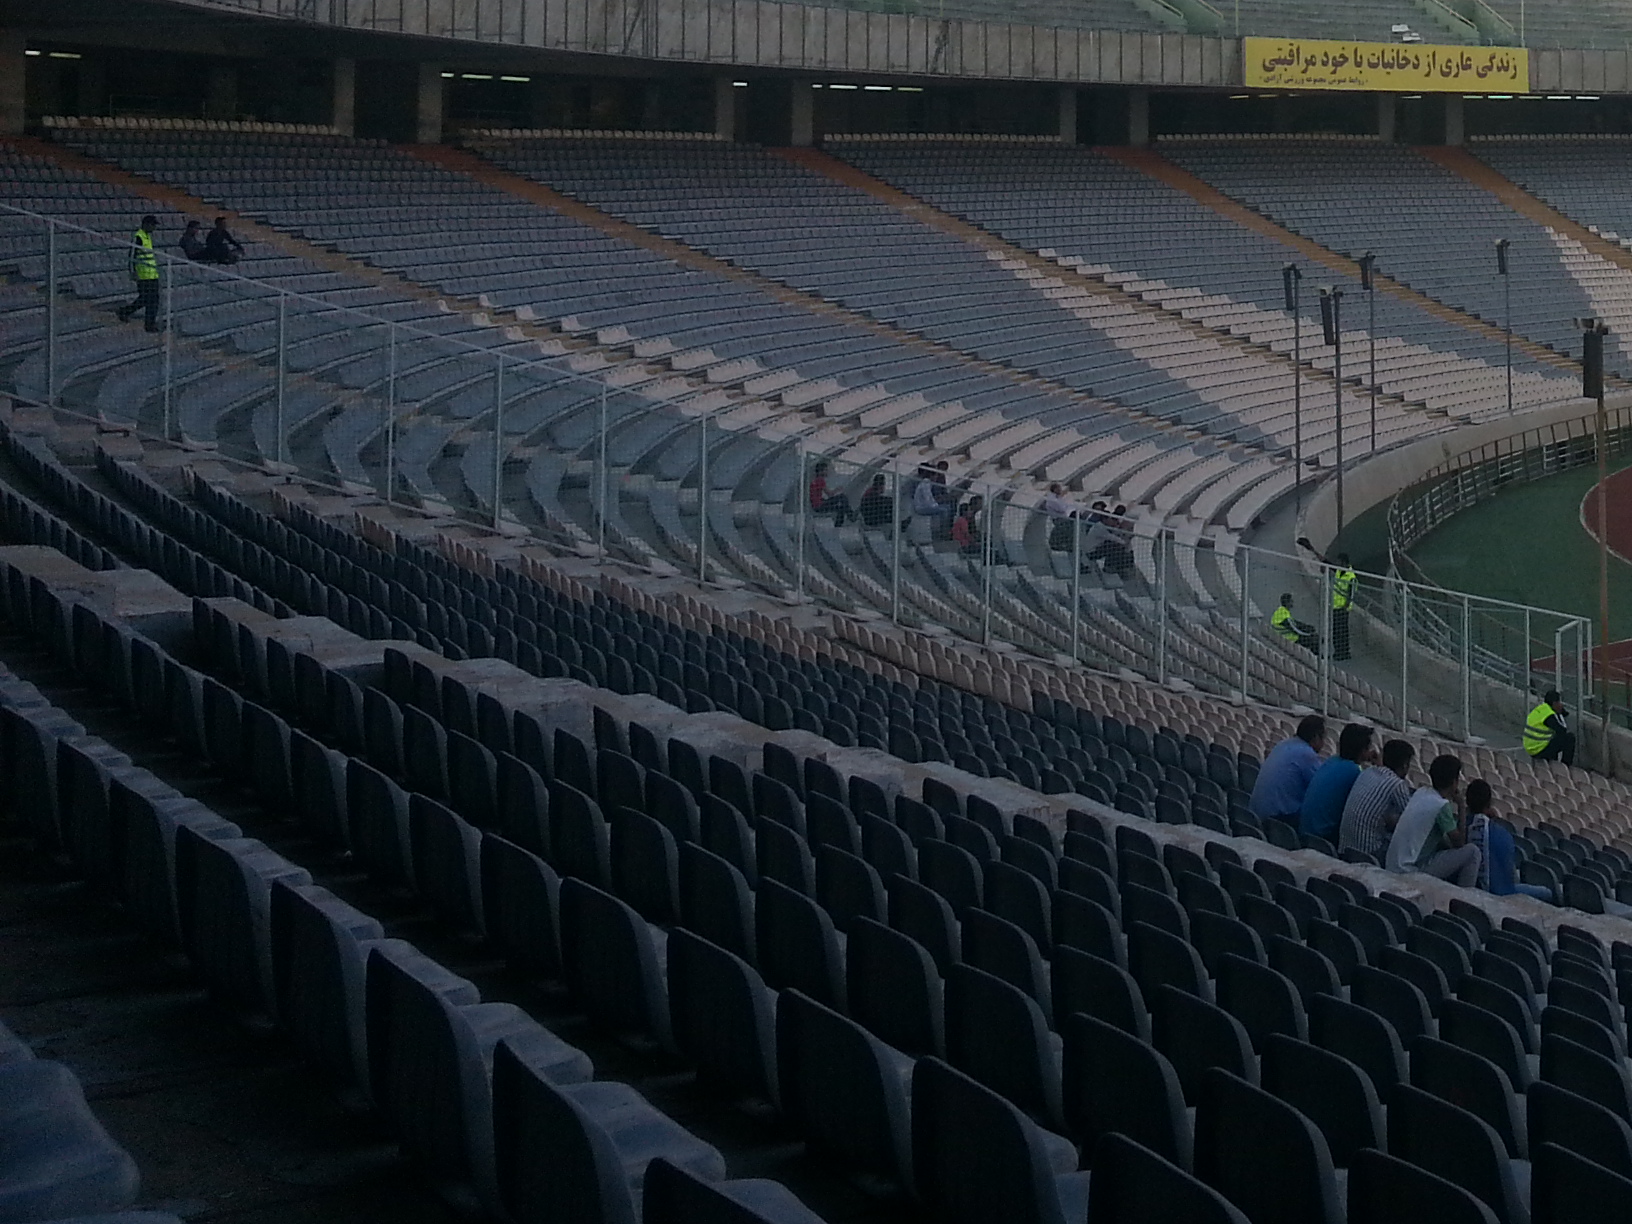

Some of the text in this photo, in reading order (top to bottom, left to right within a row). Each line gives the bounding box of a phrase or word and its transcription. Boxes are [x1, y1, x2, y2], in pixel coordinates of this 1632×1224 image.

[1262, 42, 1517, 80] زندگی عاری از دخانیات با خود مراقبتی
